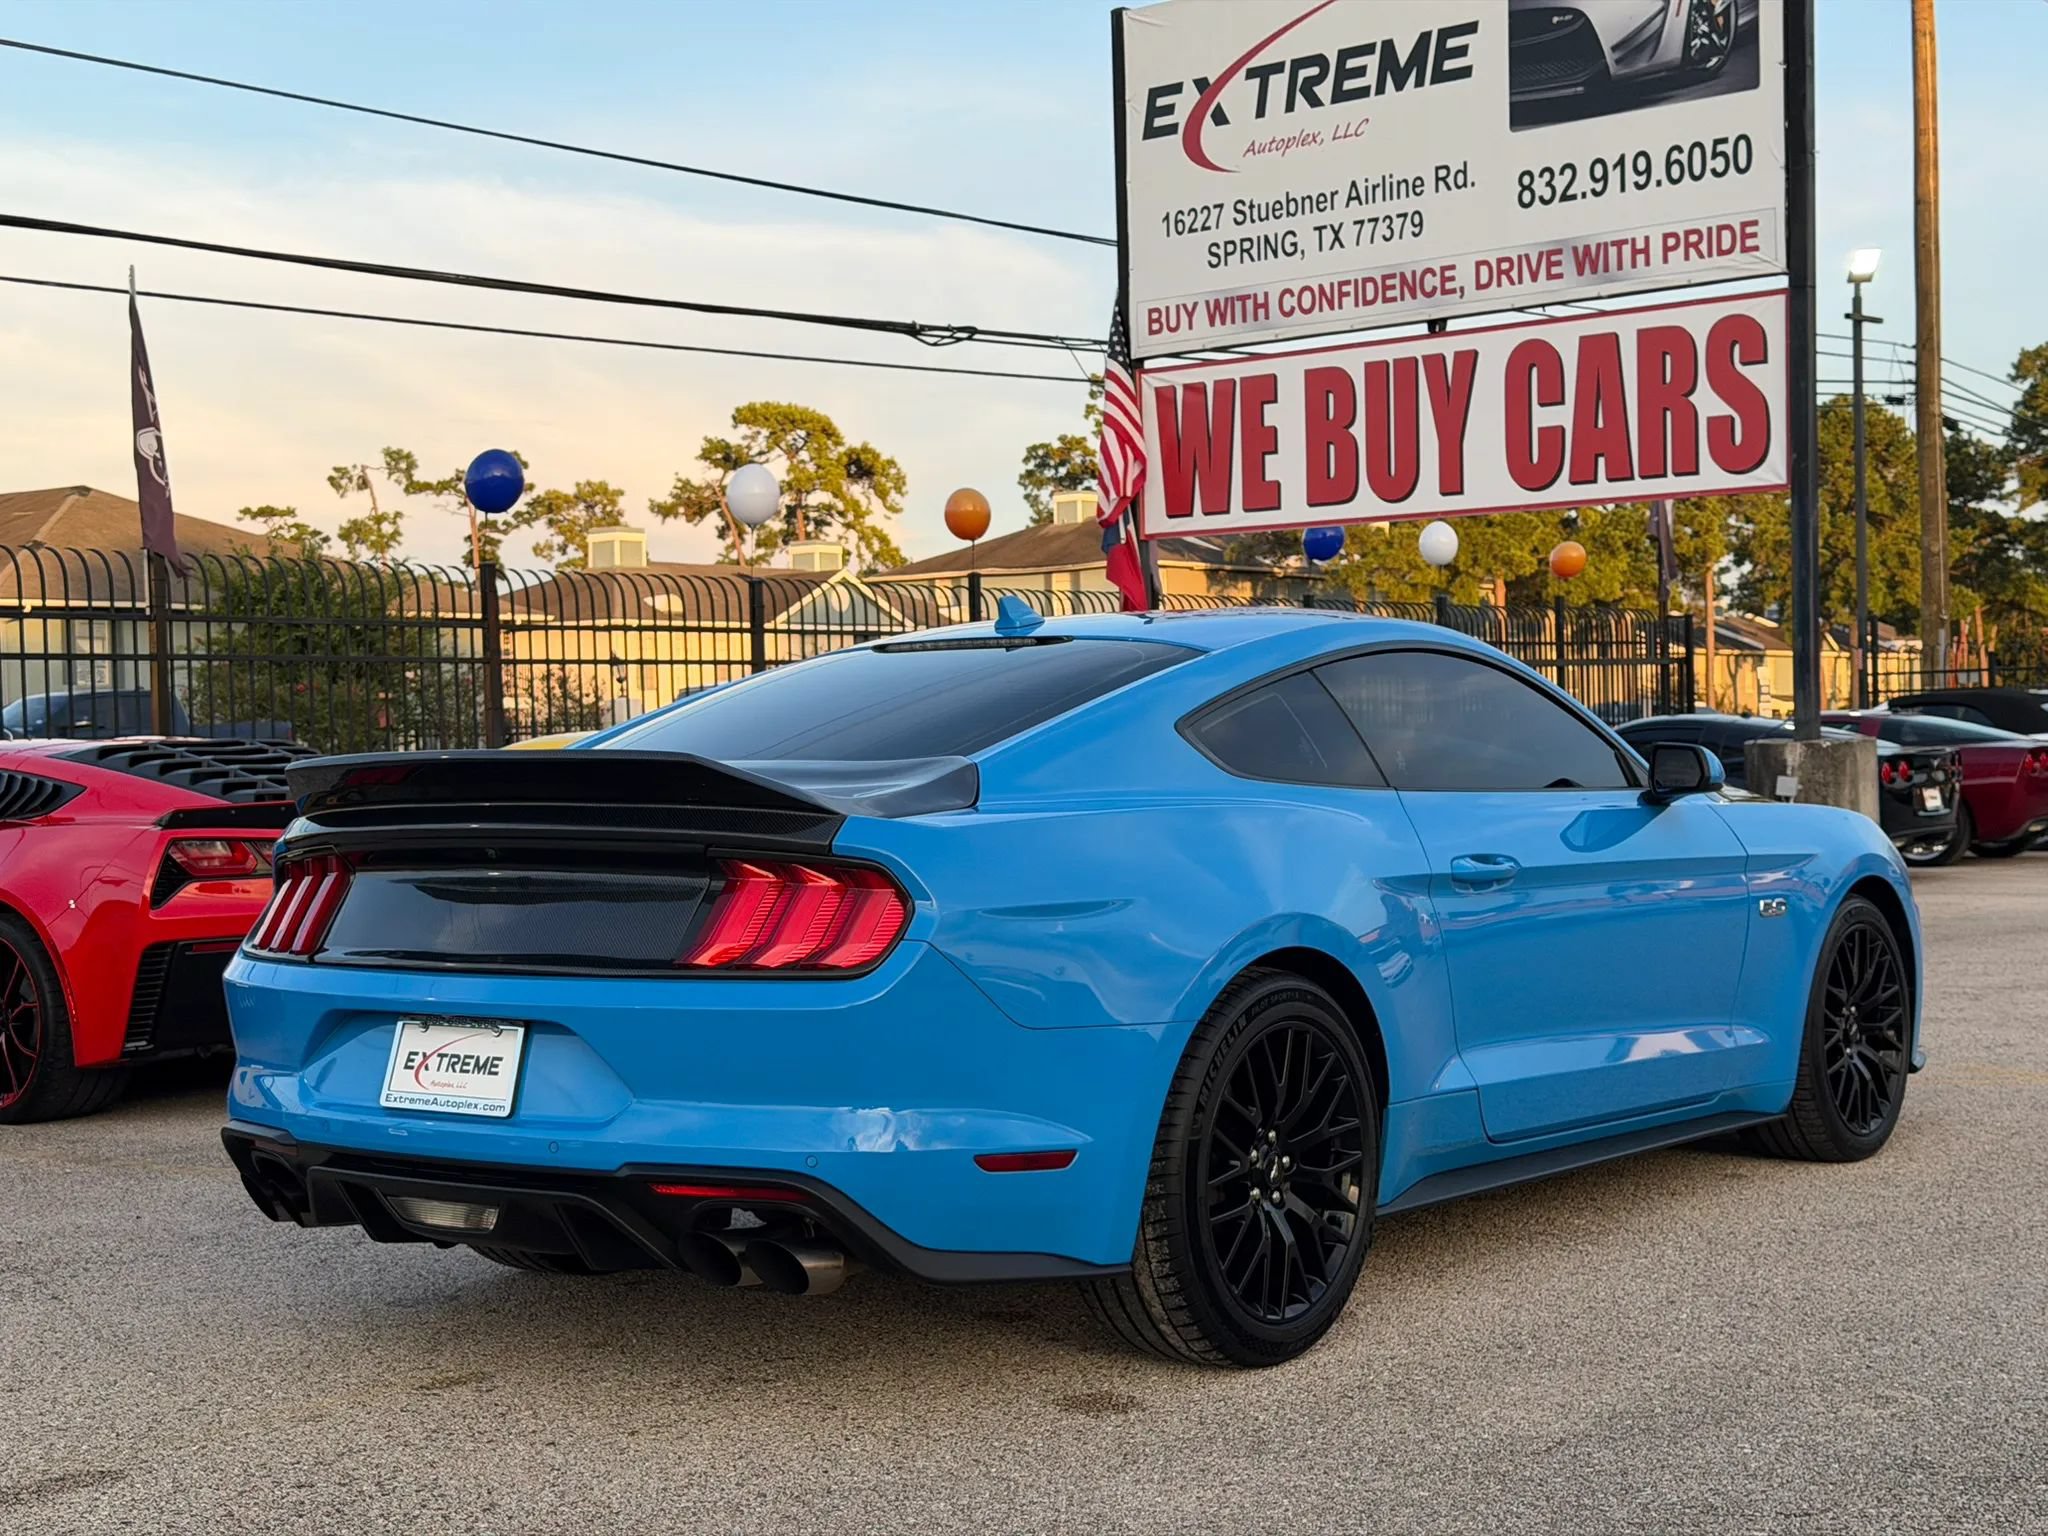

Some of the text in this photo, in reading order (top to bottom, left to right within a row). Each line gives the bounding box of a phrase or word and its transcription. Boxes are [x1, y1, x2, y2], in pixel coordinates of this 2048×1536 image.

[1142, 20, 1480, 141] EXTREME
[1243, 117, 1370, 158] Autoplex, LLC
[1517, 133, 1753, 209] 832.919.6050
[1161, 161, 1476, 238] 16227 Stuebner Airline Rd.
[1147, 219, 1760, 336] BUY WITH CONFIDENCE, DRIVE WITH PRIDE
[1207, 210, 1424, 269] SPRING, TX 77379
[1154, 313, 1770, 519] WE BUY CARS
[403, 1051, 504, 1076] EXTREME
[1199, 1013, 1249, 1110] MICHELIN
[385, 1093, 506, 1112] ExtremeAutoplex.com
